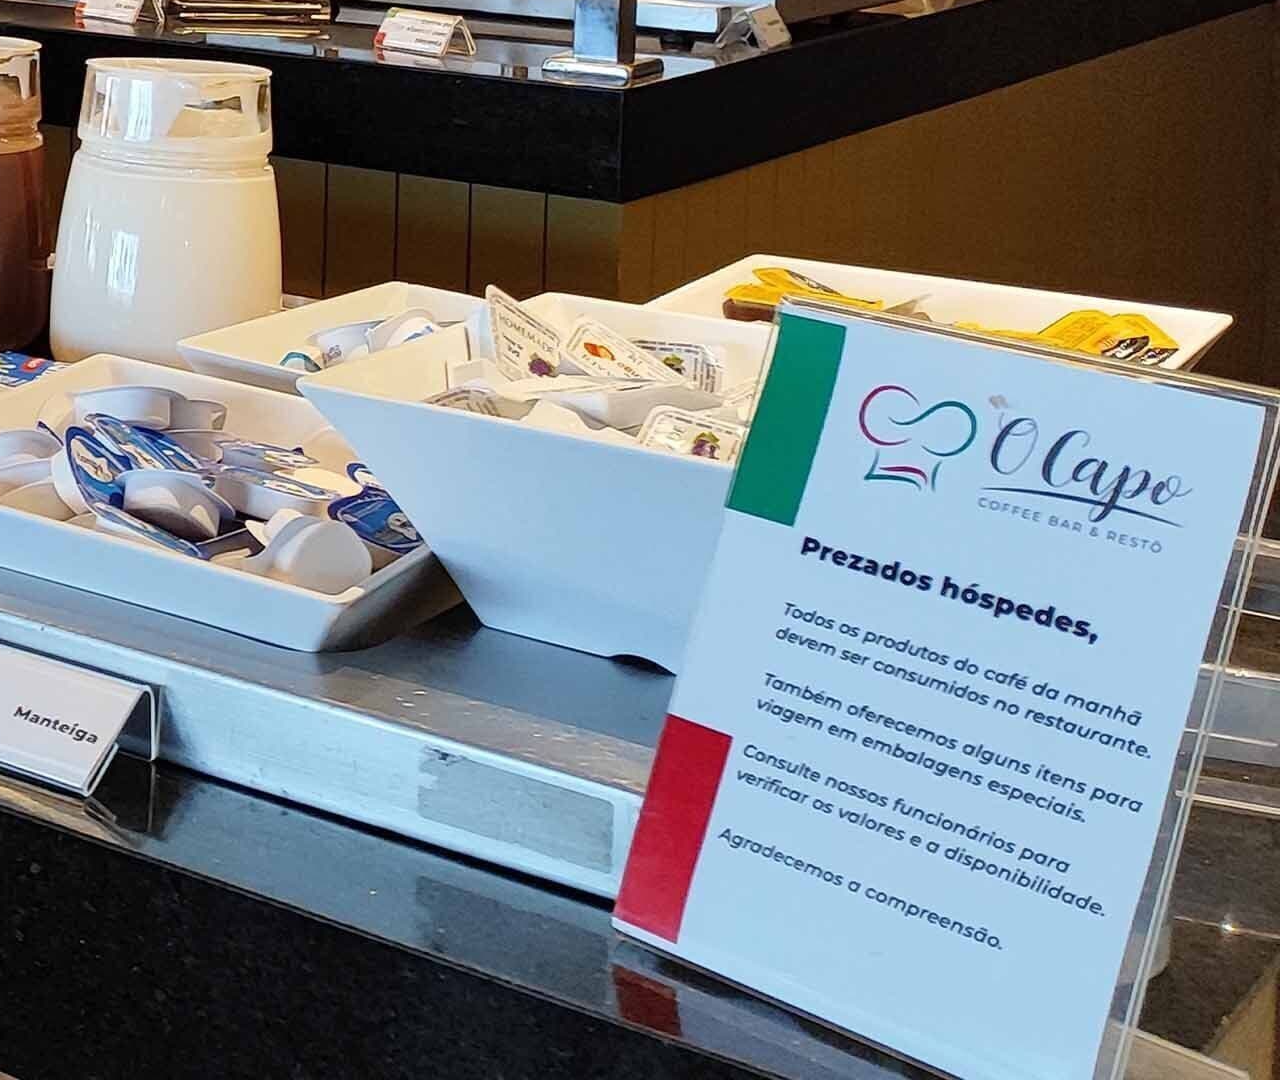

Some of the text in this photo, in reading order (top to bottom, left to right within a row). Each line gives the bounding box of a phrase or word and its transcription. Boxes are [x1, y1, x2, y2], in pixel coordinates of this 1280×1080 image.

[977, 497, 1041, 522] COFFEE
[1047, 515, 1082, 533] BAR
[1089, 526, 1099, 537] &
[990, 416, 1192, 522] O Capo
[800, 536, 1098, 645] Prezados hóspedes,
[13, 705, 99, 746] Manteiga
[775, 626, 1151, 759] devem ser consumidos no restaurante.
[784, 602, 1142, 726] Todos os produtos do café da manhã
[757, 698, 1086, 823] viagem em embalagens especiais.
[765, 672, 1143, 813] Também oferecemos alguns itens para
[737, 770, 1105, 917] verificar os valores e a disponibilidade.
[743, 744, 1071, 873] Consulte nossos funcionários para
[718, 827, 1003, 951] Agradecemos a compreensão.
